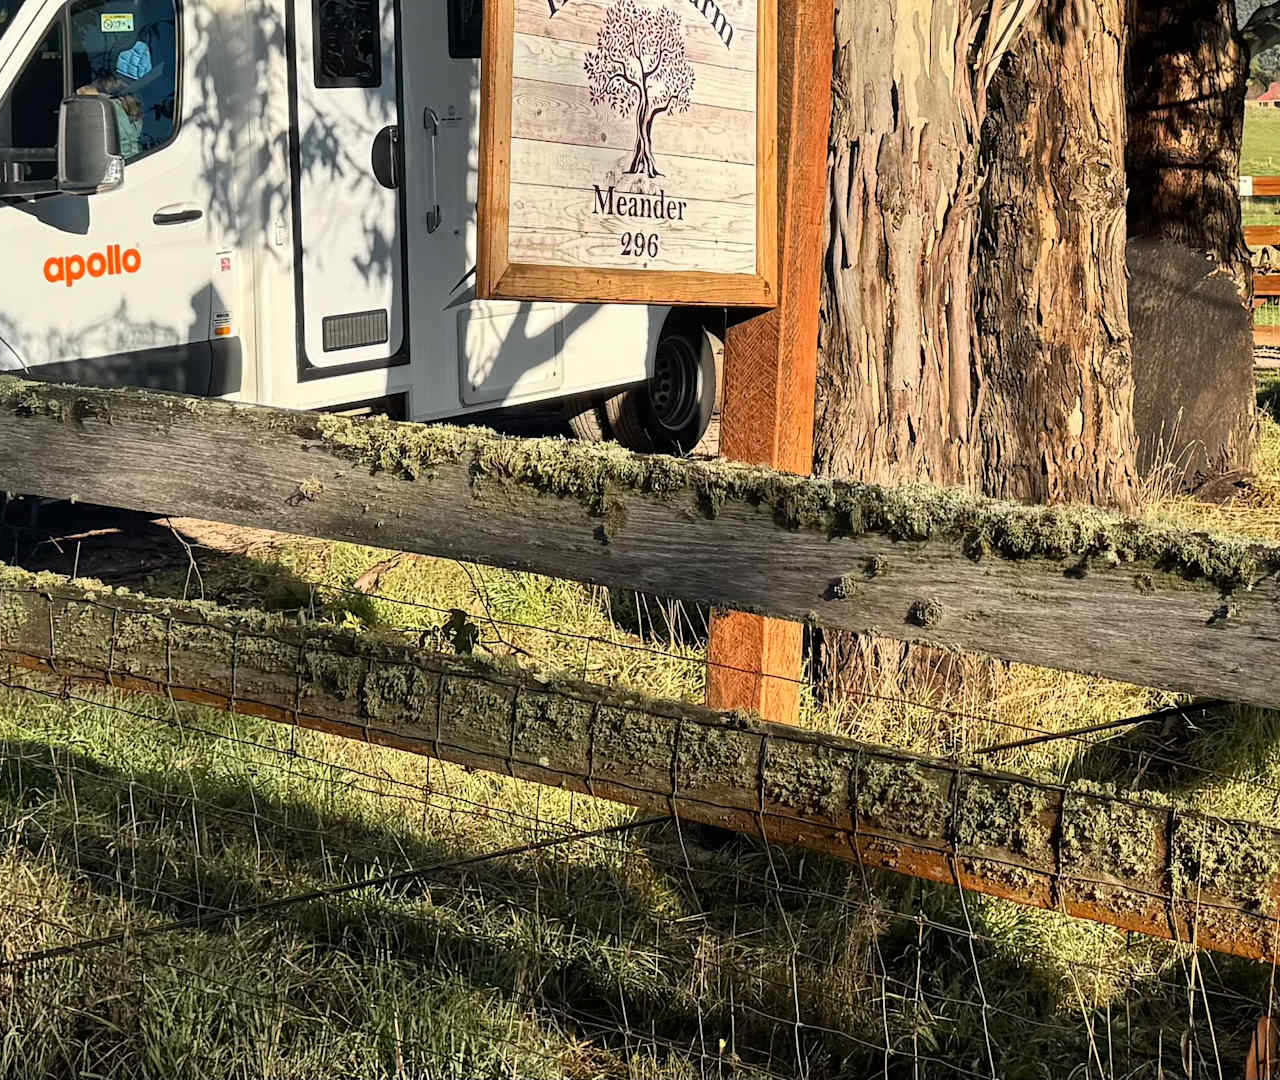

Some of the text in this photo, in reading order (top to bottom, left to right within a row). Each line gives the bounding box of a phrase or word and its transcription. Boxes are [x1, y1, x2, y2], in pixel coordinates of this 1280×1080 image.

[592, 184, 687, 221] Meander
[621, 232, 659, 258] 296
[43, 243, 141, 287] apollo
